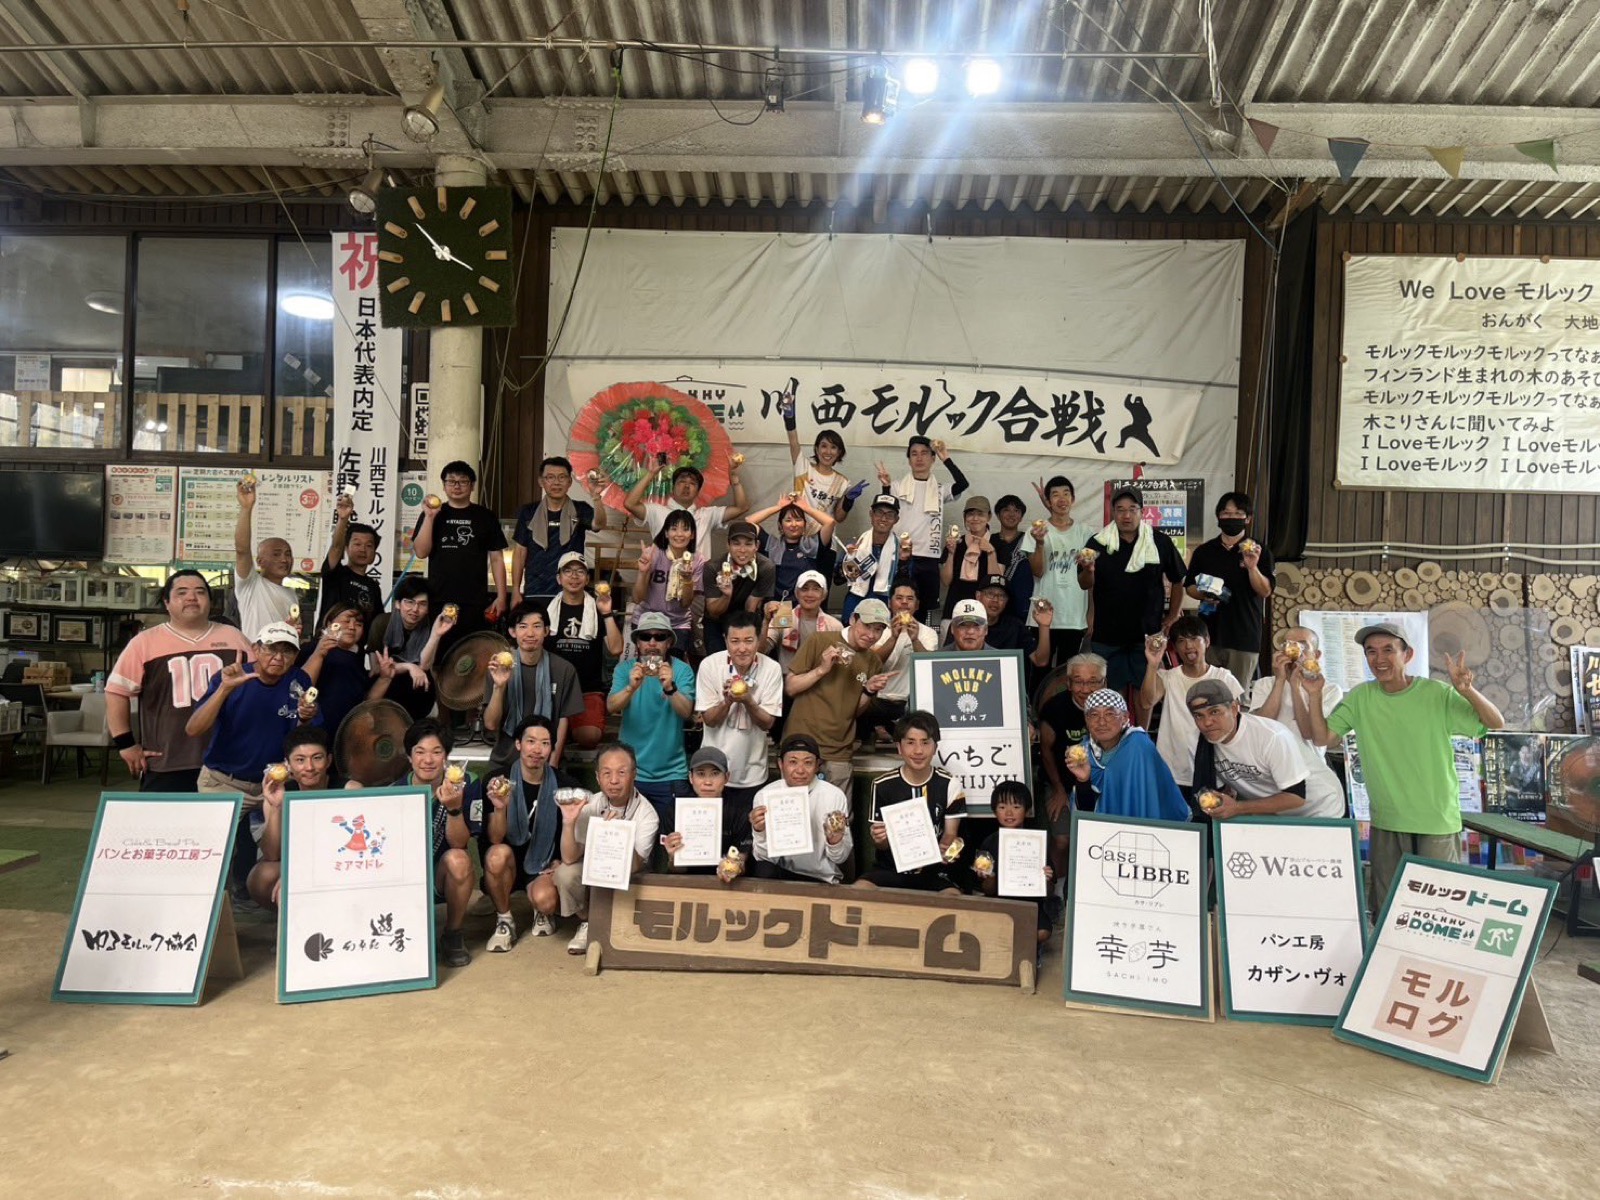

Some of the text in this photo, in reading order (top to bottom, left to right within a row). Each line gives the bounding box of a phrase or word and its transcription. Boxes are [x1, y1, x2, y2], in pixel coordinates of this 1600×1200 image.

[339, 231, 379, 291] 祝
[1399, 279, 1594, 301] We Love モルック
[1482, 313, 1599, 330] おんがく 大地
[351, 297, 377, 432] 日本代表内定
[761, 376, 1106, 454] 川西モルック合戦
[1363, 413, 1555, 432] 木こりさんに聞いてみよ
[1361, 434, 1600, 453] I Loveモルック I Loveモル
[1360, 455, 1600, 474] I Loveモルック I Loveモル
[167, 652, 224, 709] 10
[954, 680, 980, 694] HUB
[937, 744, 1012, 768] いちご
[334, 859, 384, 871] ミアマドレ
[1088, 844, 1137, 864] Casa
[1118, 863, 1190, 885] LIBRE
[1260, 856, 1343, 879] Wacca
[1407, 879, 1530, 917] モルックドーム
[633, 899, 981, 972] モルックドーム
[1261, 934, 1325, 951] パン工房
[1248, 964, 1348, 987] カザン・ヴォ
[1401, 968, 1471, 1008] モル
[1386, 1000, 1463, 1038] ログ
